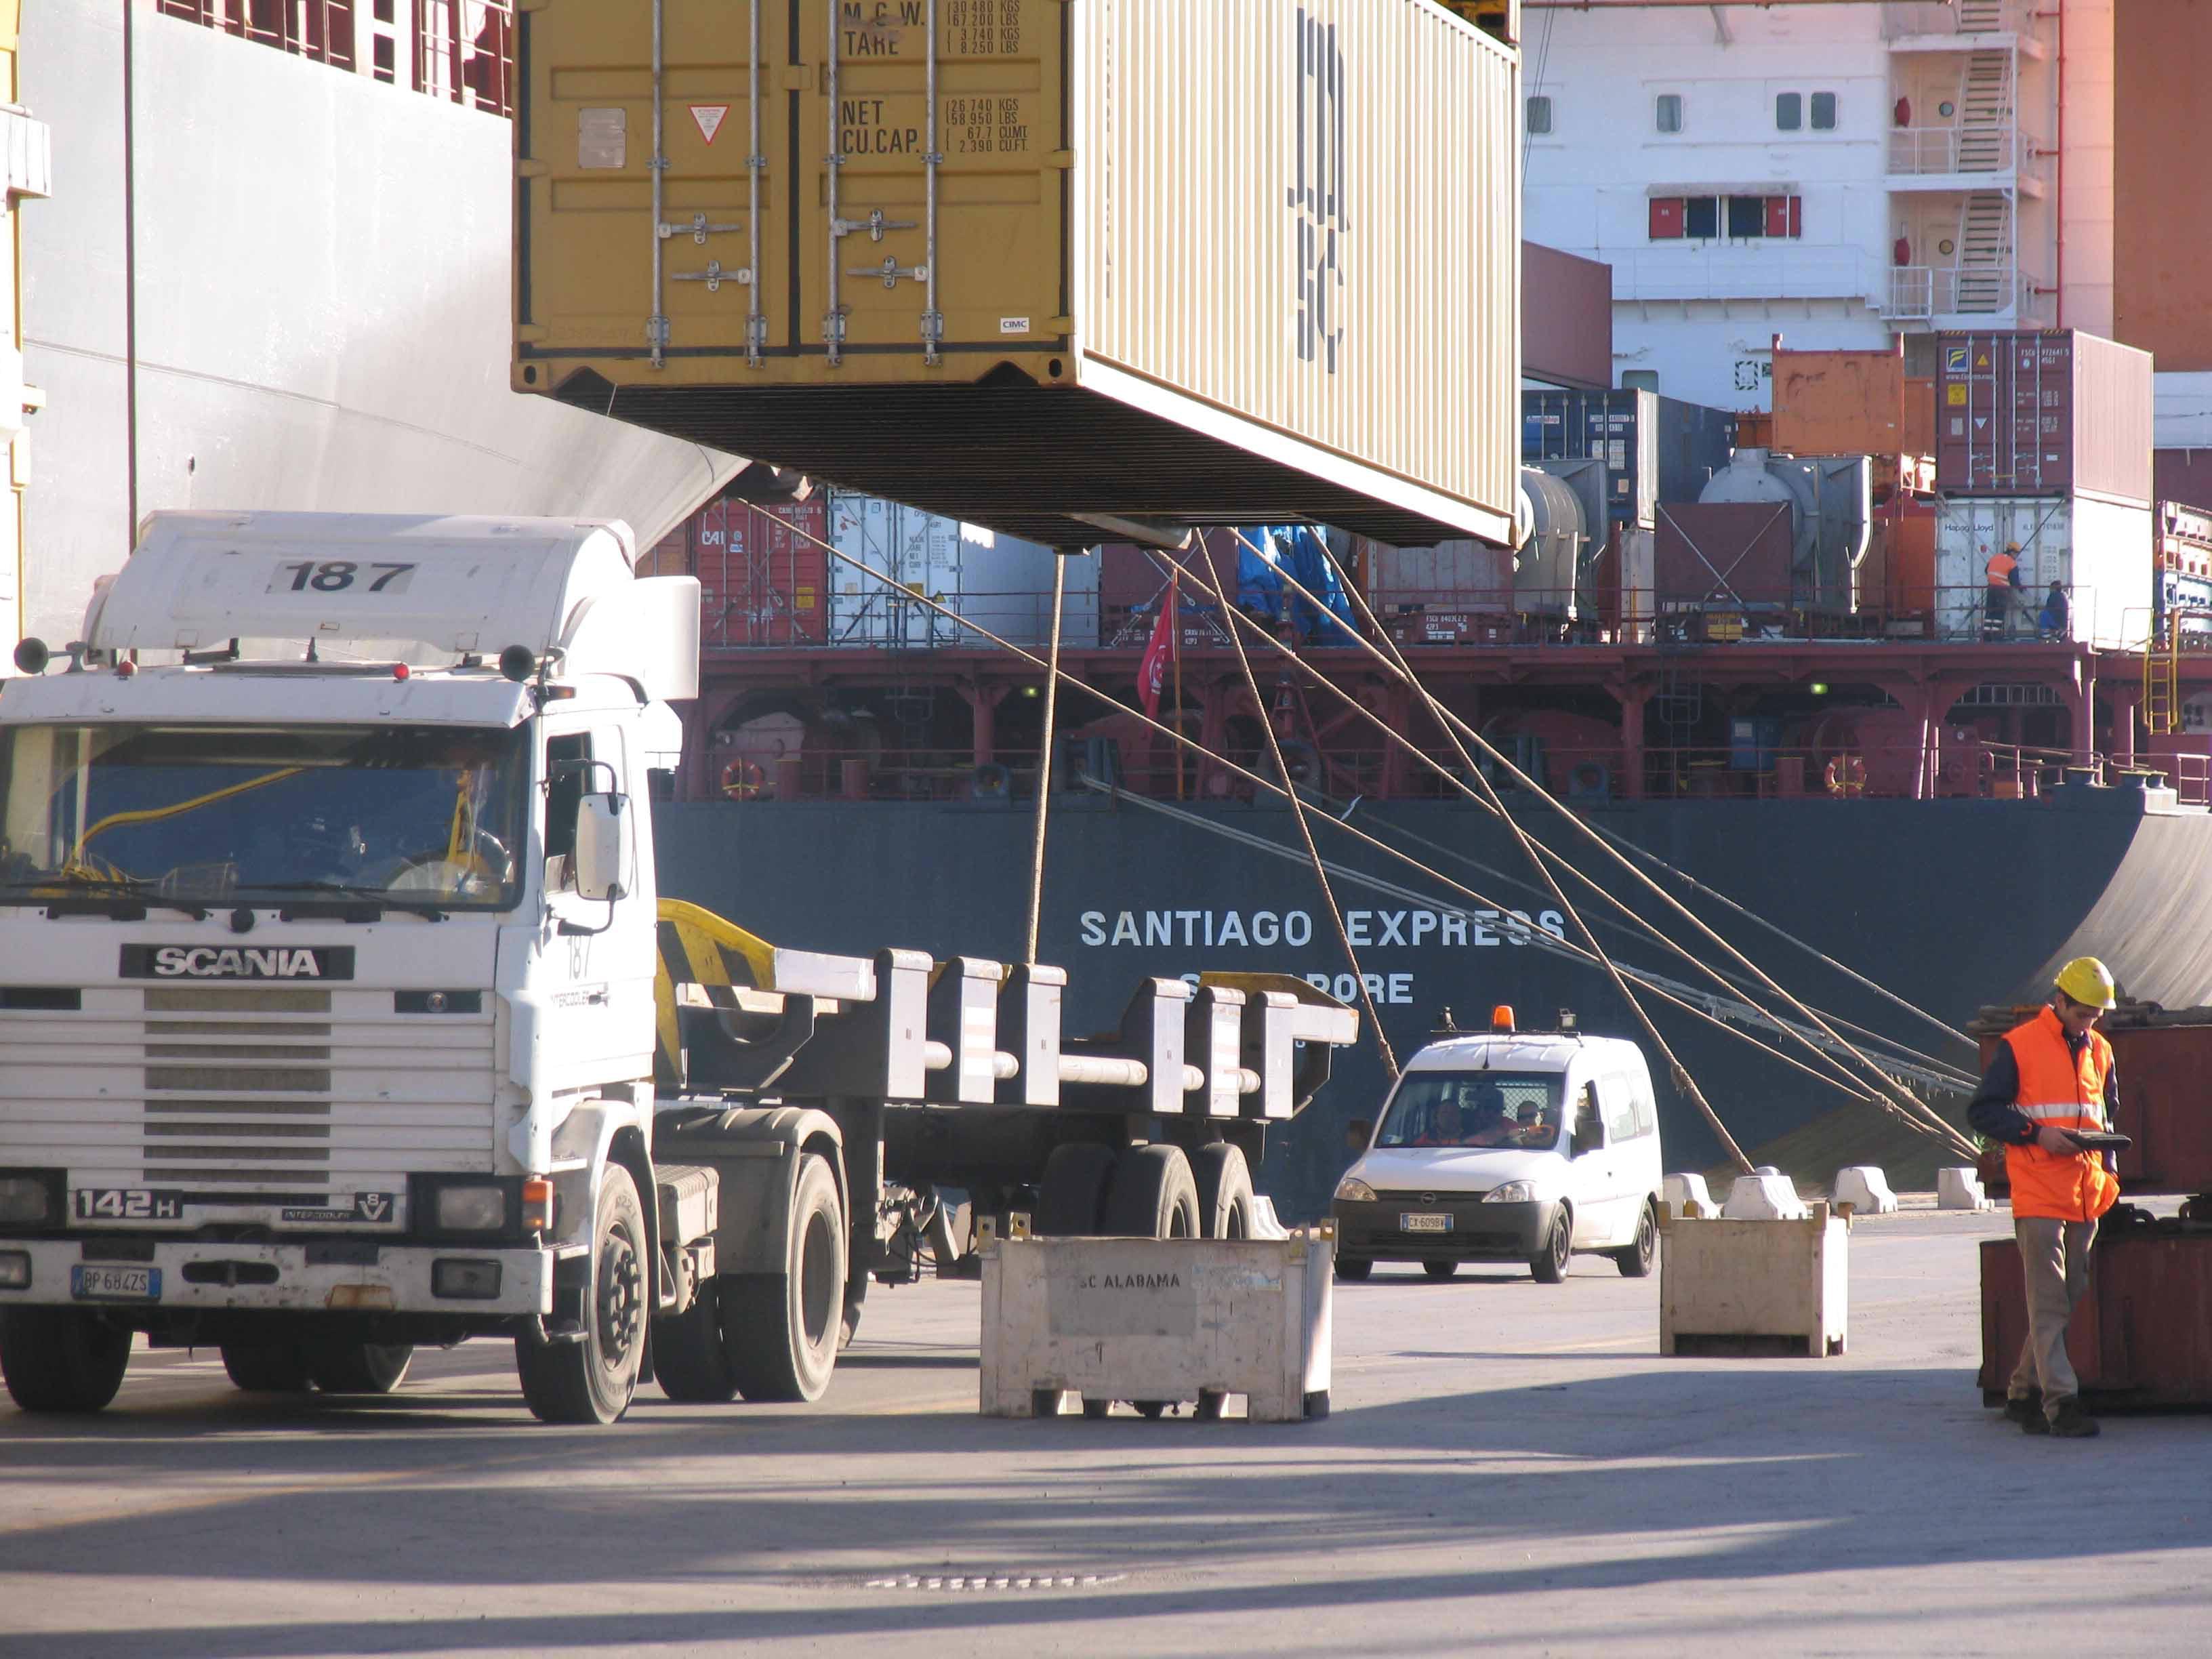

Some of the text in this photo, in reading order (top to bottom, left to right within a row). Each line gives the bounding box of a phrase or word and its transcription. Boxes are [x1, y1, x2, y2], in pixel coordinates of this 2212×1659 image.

[1000, 0, 1020, 13] KGS
[1000, 12, 1019, 26] LBS
[1000, 26, 1020, 40] KGS
[1000, 40, 1019, 54] LBS
[842, 100, 884, 126] NET
[998, 98, 1019, 111] KGS
[998, 111, 1018, 125] LBS
[841, 128, 921, 155] CU.CAP.
[1002, 320, 1027, 329] CIMC
[1973, 524, 1994, 532] Lloyd
[285, 560, 415, 592] 187
[1080, 910, 1565, 947] SANTIAGO EXPRESS
[155, 947, 320, 977] SCANIA
[1179, 973, 1414, 1004] SPORE
[1105, 1274, 1180, 1288] ALABAMA
